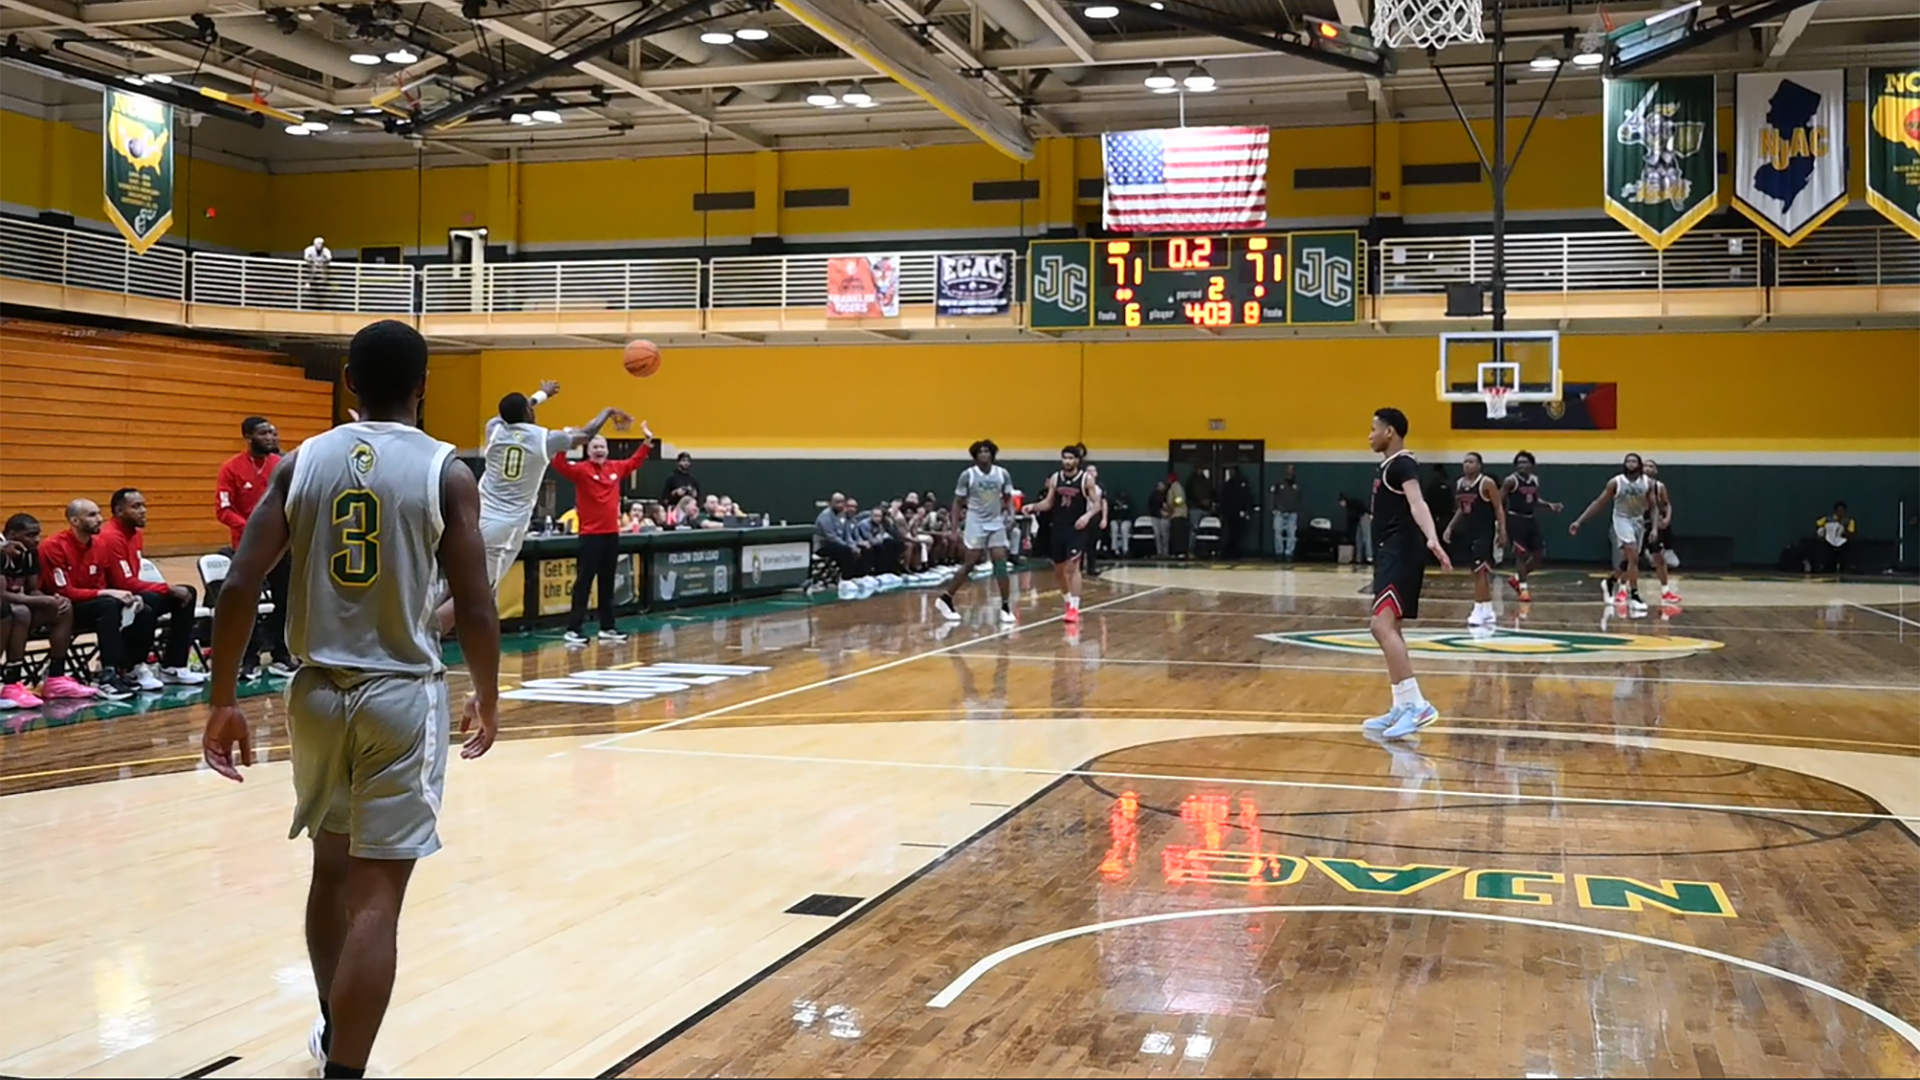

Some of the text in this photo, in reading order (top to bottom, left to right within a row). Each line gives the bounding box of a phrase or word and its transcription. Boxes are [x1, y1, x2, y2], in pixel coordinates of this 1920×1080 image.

[1759, 126, 1829, 171] NJAC
[940, 255, 1004, 281] ECAC
[1168, 237, 1212, 269] 0.2
[1245, 252, 1282, 283] 71
[1034, 255, 1087, 313] JC
[1107, 255, 1143, 286] 71
[1295, 247, 1353, 308] JC
[1207, 276, 1226, 301] 2
[1124, 302, 1142, 327] 6
[503, 445, 526, 482] 0
[330, 487, 382, 587] 3
[543, 561, 563, 578] Get
[543, 582, 562, 599] the
